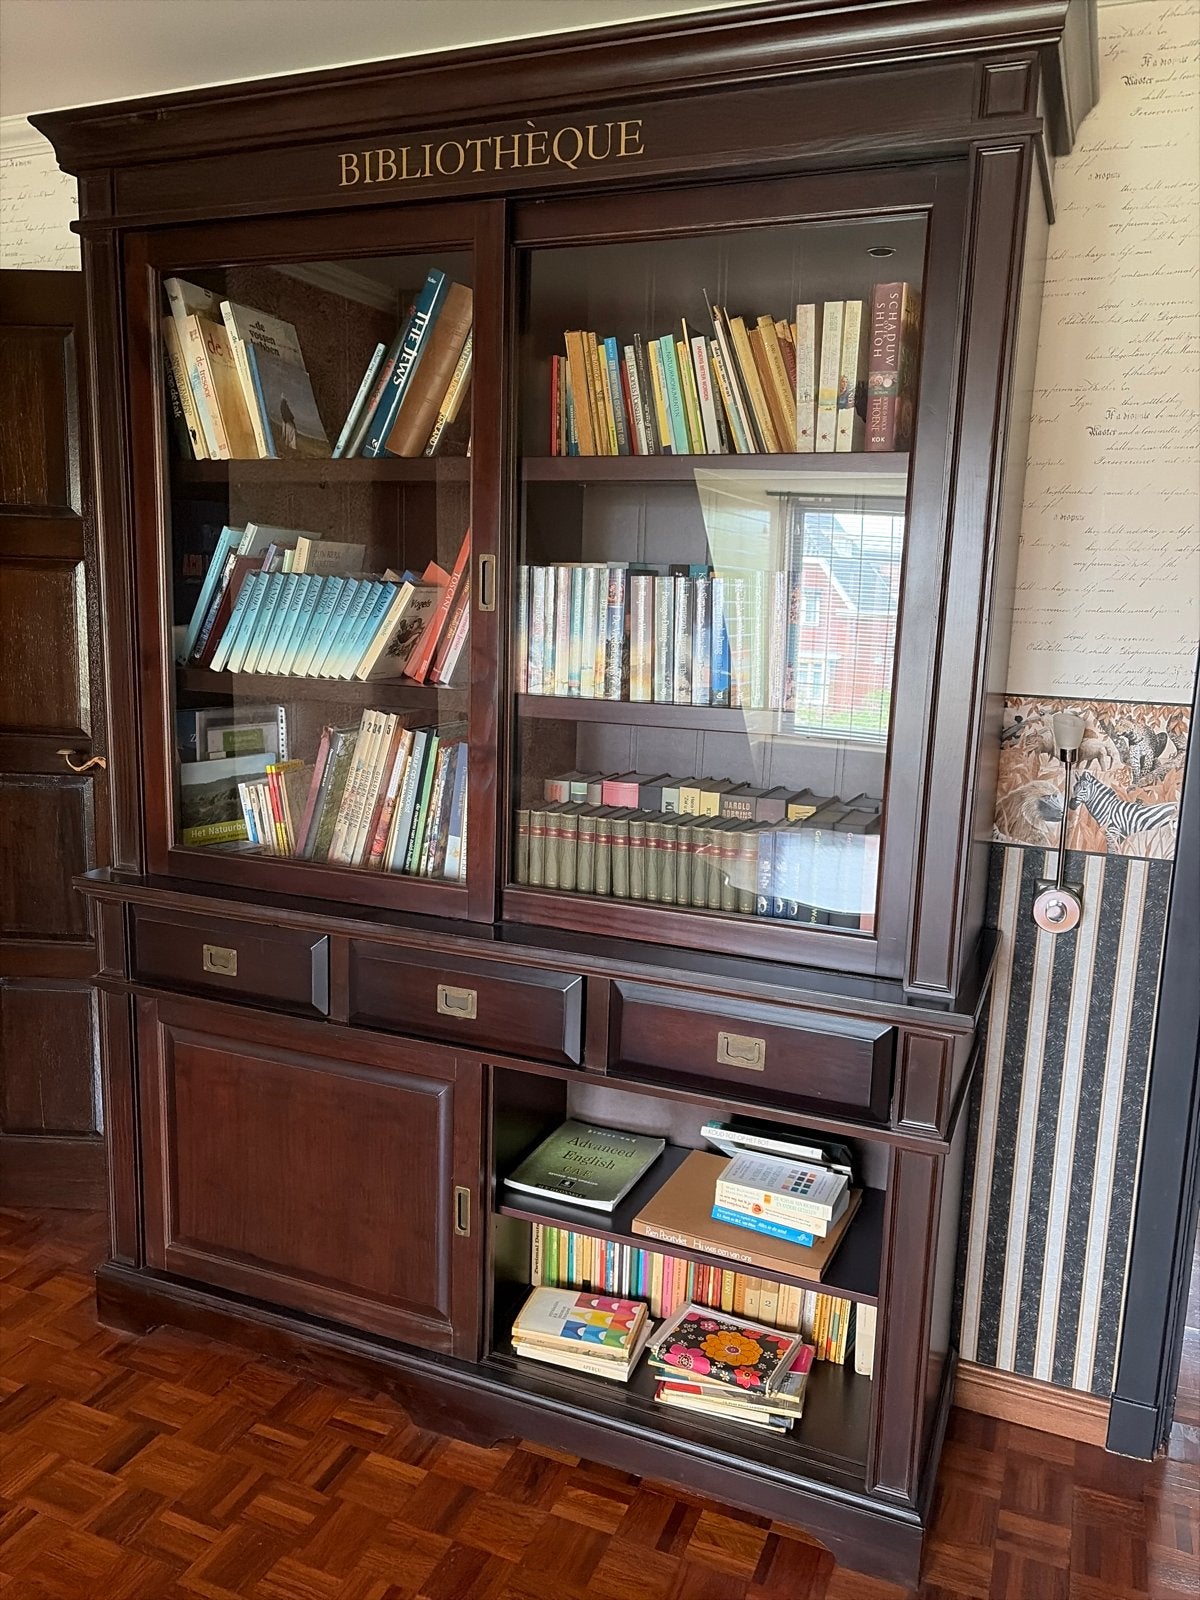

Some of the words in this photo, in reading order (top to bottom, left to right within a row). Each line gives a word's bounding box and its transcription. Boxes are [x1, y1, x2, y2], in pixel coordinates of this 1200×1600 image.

[337, 119, 645, 187] BIBLIOTHÈQUE
[408, 310, 429, 343] THE
[872, 303, 886, 358] SHILOH
[885, 292, 899, 366] SCHADUW
[393, 343, 418, 386] JEWS
[664, 351, 681, 417] NATUURMONUMENTEN
[872, 398, 882, 432] THOENE
[871, 435, 885, 445] KOK
[410, 599, 432, 612] Vogels
[442, 572, 461, 612] TOSCANE
[658, 619, 669, 642] Danzig
[723, 801, 751, 810] HAROLD
[191, 829, 207, 839] Het
[567, 1137, 637, 1158] Advanced
[707, 1128, 725, 1139] KOUD
[725, 1131, 737, 1142] TOT
[757, 1138, 770, 1147] BOT
[562, 1150, 617, 1171] English
[533, 1243, 541, 1275] Zweimal
[645, 1225, 660, 1239] Rien
[740, 1253, 752, 1263] ons
[748, 1297, 754, 1306] 1
[764, 1299, 772, 1308] 2
